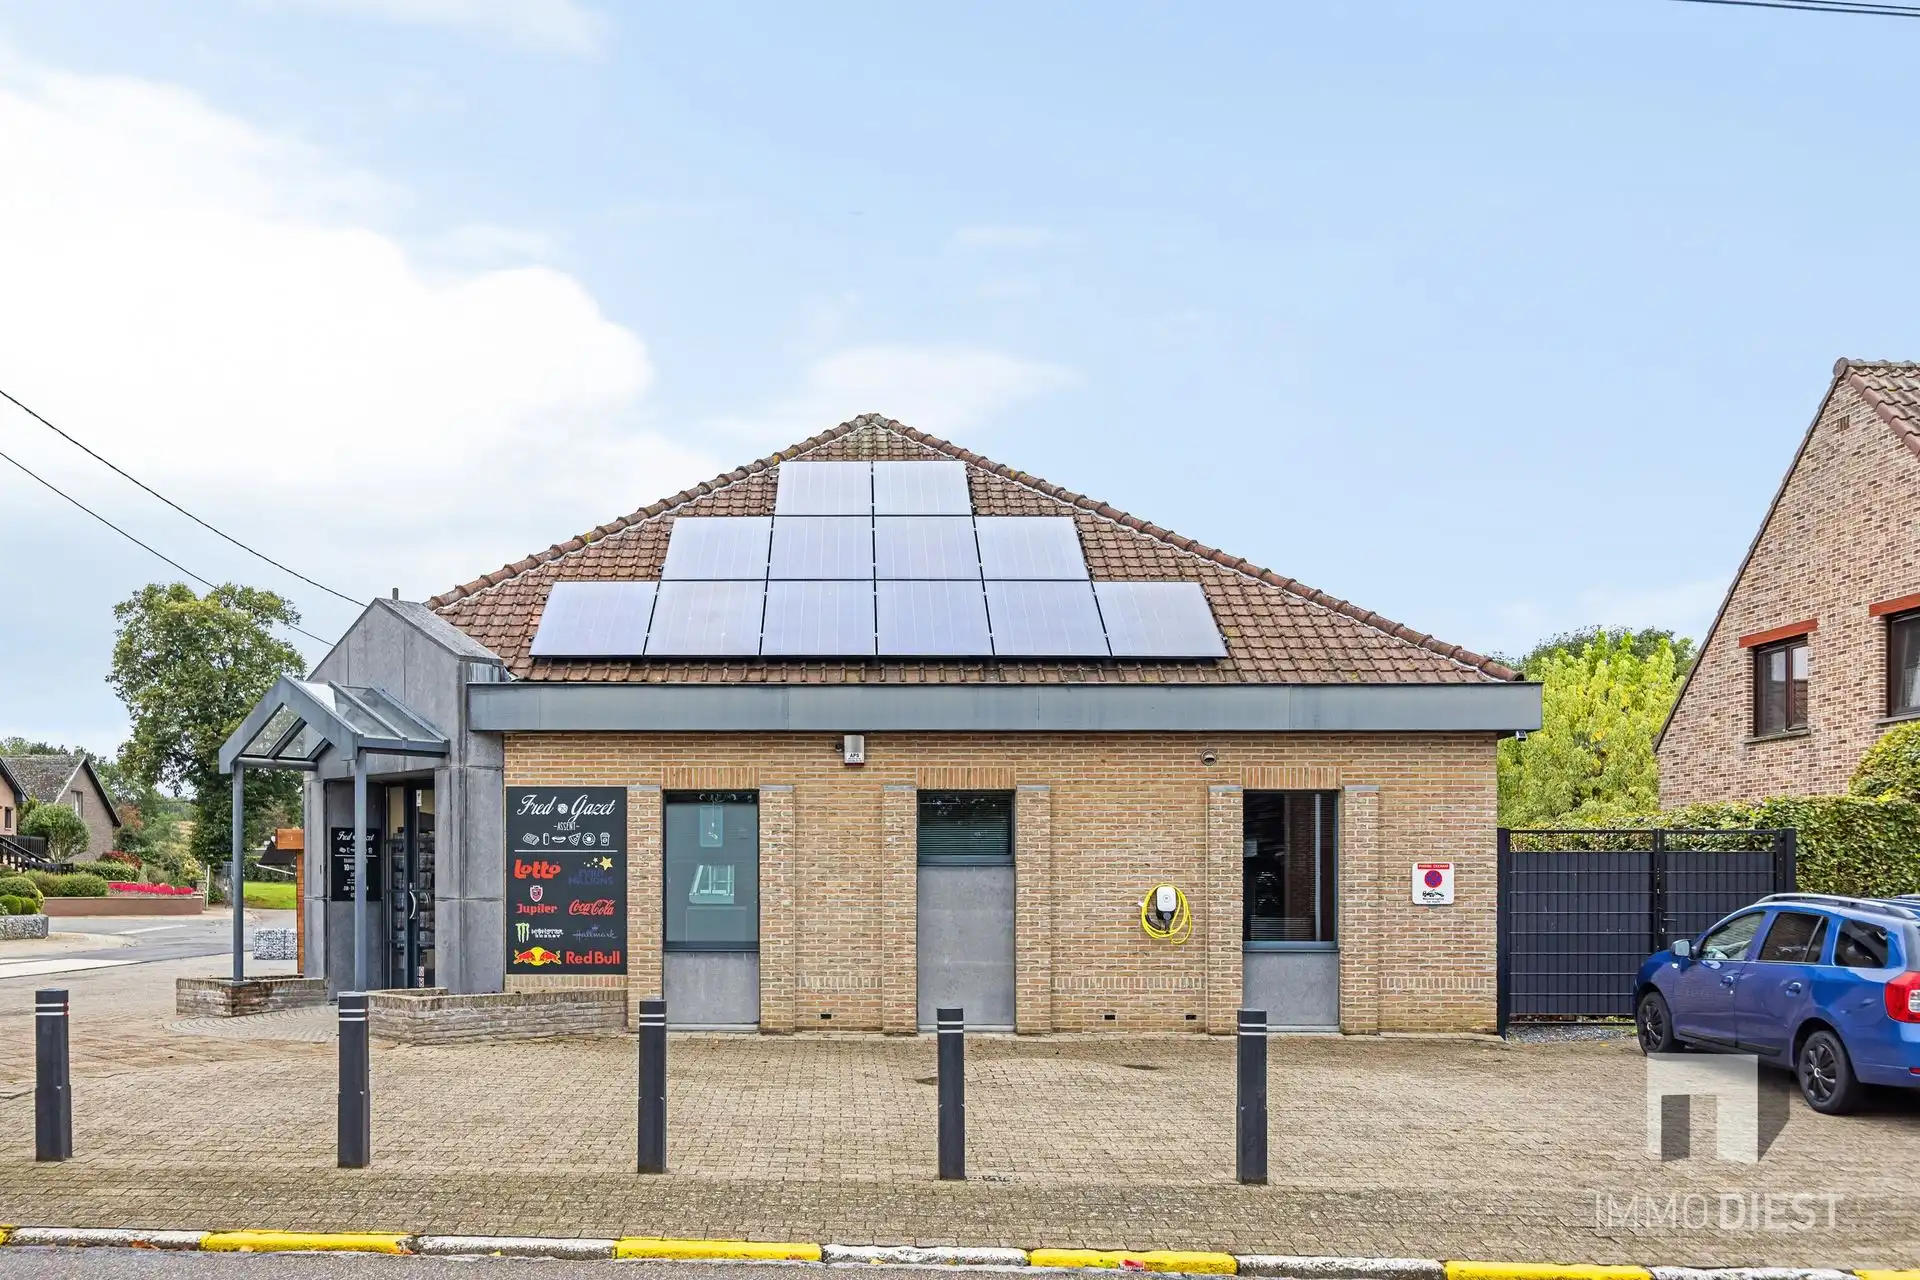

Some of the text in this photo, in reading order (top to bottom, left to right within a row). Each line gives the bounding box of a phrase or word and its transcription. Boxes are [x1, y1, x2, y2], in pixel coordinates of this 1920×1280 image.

[516, 794, 616, 823] Fred Gazet
[514, 859, 561, 880] Lotto
[516, 903, 558, 916] Jupiler
[572, 929, 618, 942] Hallmark
[565, 951, 621, 965] Red Bull
